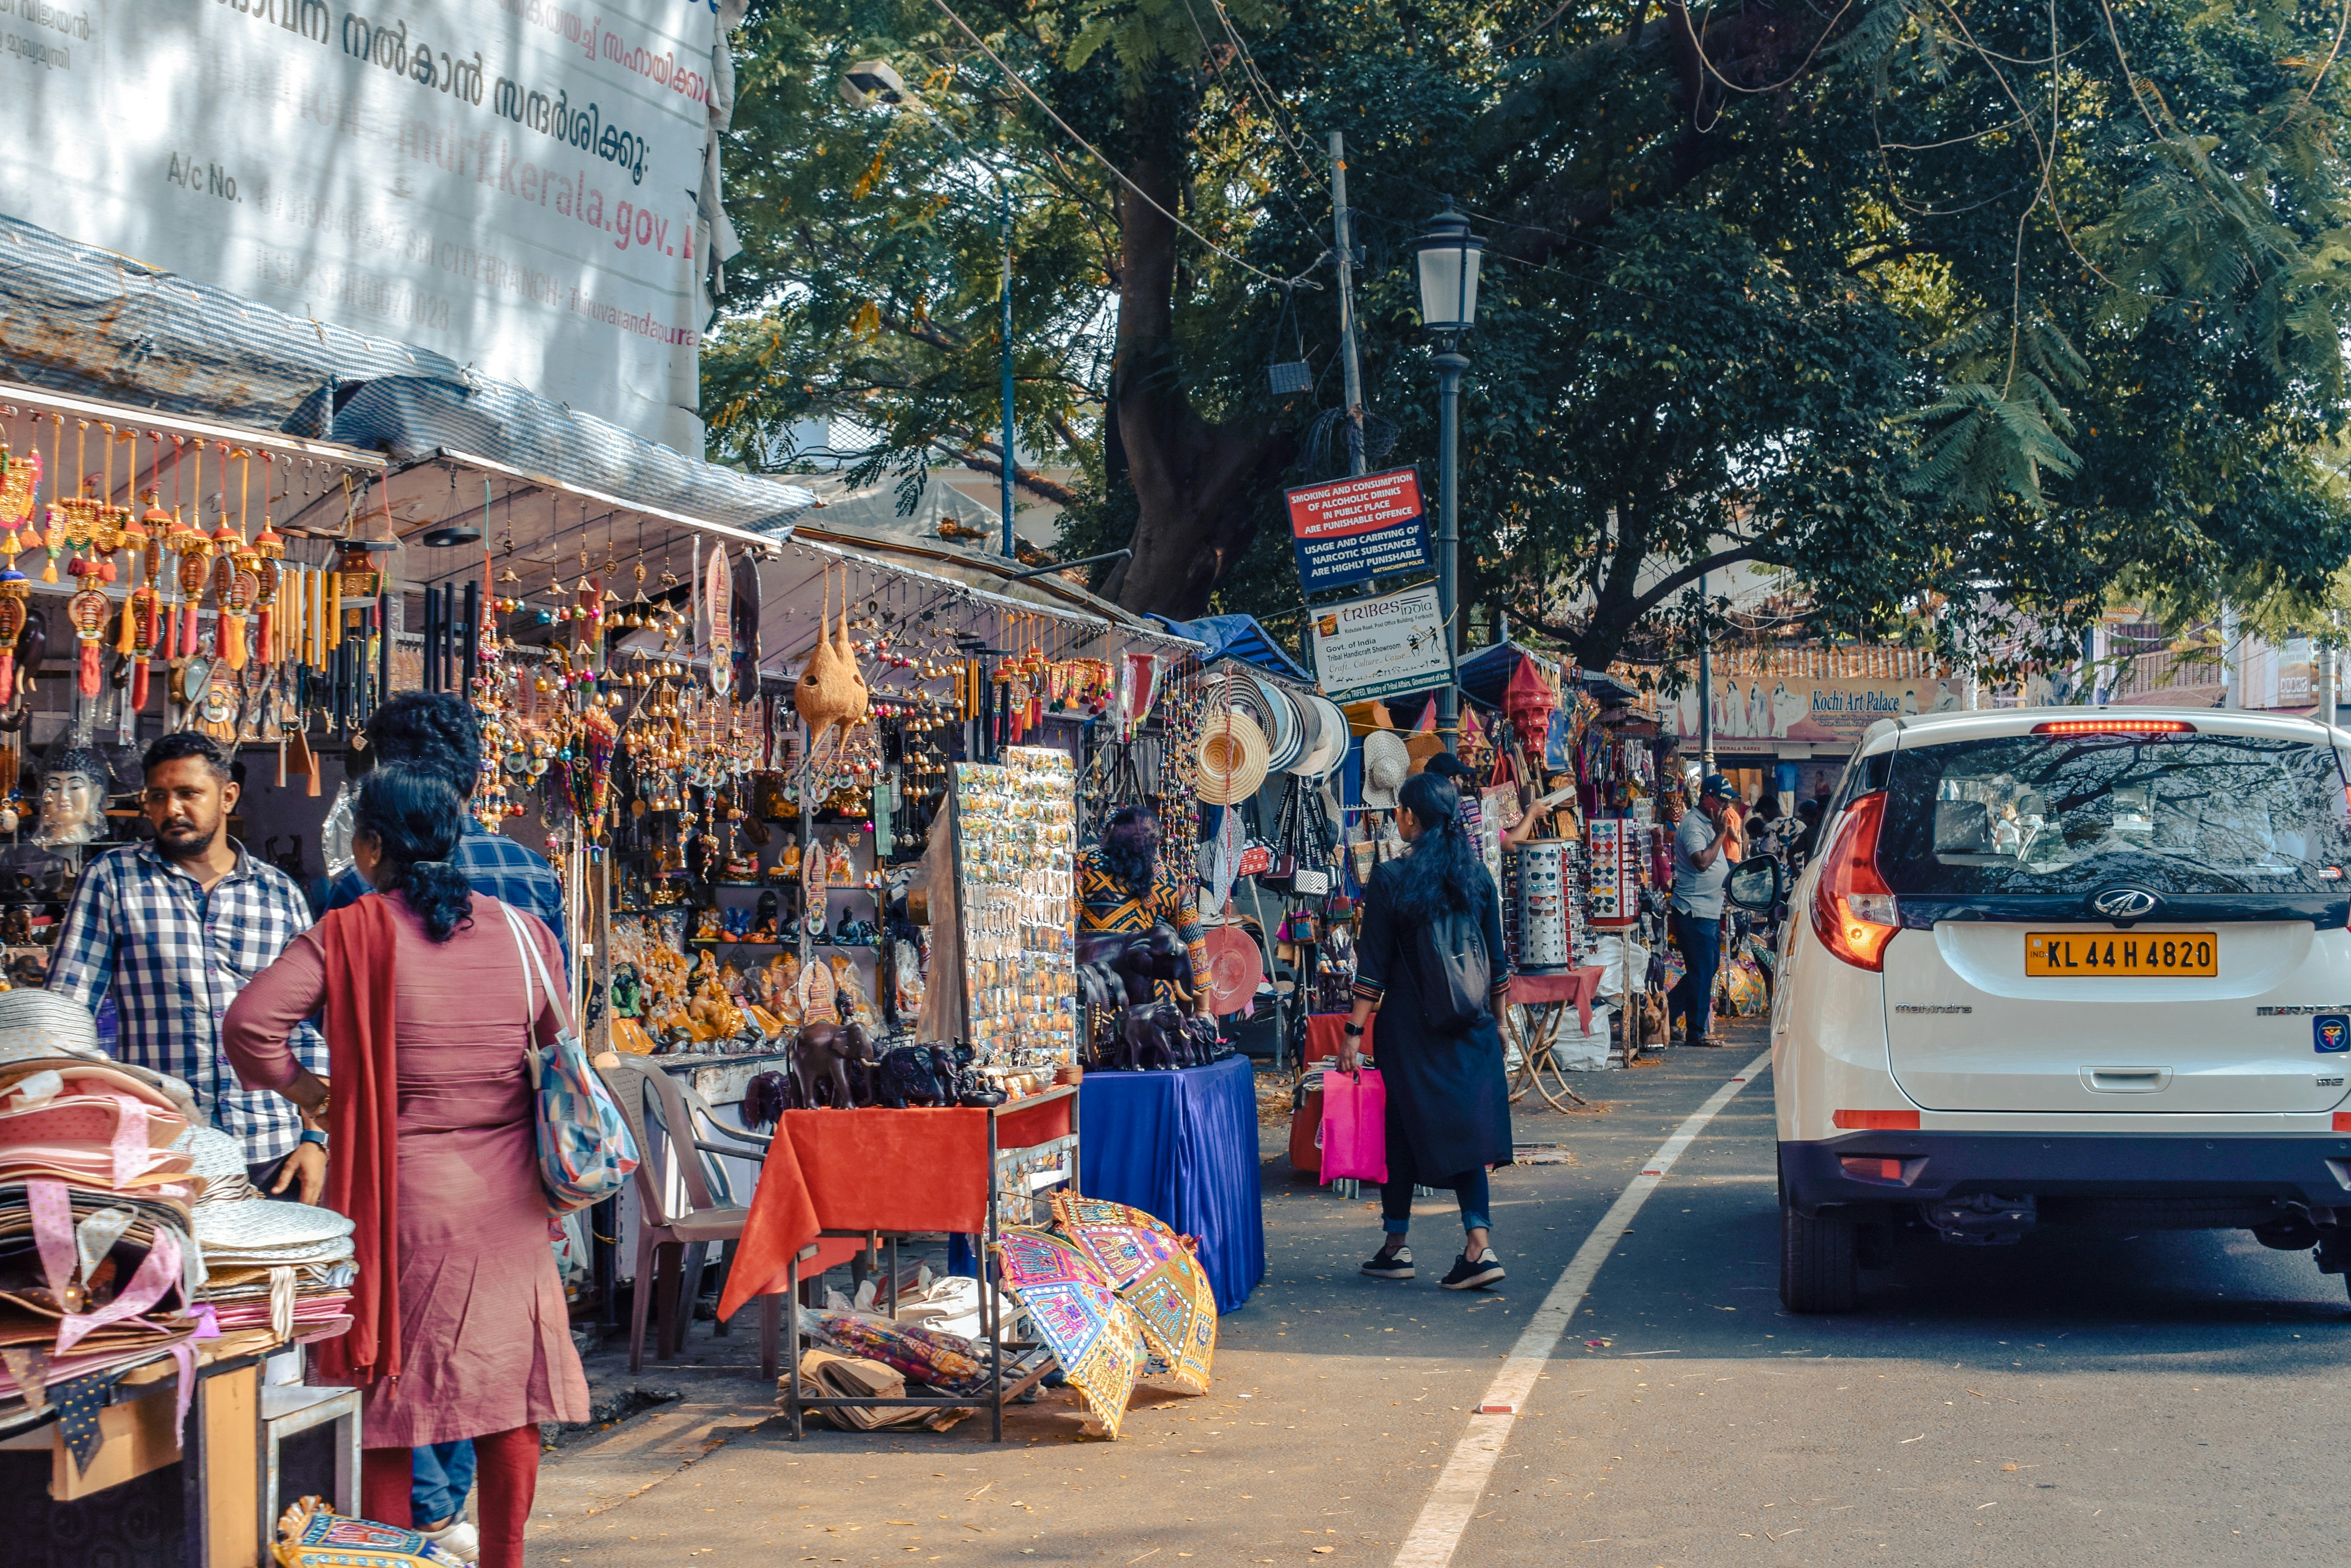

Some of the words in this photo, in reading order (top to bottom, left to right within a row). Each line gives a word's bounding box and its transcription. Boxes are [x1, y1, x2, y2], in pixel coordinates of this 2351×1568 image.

[343, 12, 484, 107] നൽകാൻ
[167, 151, 203, 191] A/c
[209, 162, 242, 204] No.
[1291, 490, 1330, 504] SMOKING
[1333, 485, 1351, 496] AND
[1352, 473, 1413, 492] CONSUMPTION
[1308, 502, 1320, 512] OF
[1321, 493, 1370, 509] ALCOHOLIC
[1371, 486, 1401, 500] DRINKS
[1305, 524, 1321, 534] ARE
[1323, 514, 1374, 531] PUNISHABLE
[1375, 506, 1413, 521] OFFENCE
[1323, 511, 1333, 520] IN
[1334, 505, 1363, 518] PUBLIC
[1364, 500, 1391, 512] PLACE
[1305, 542, 1335, 555] USAGE
[1337, 537, 1357, 549] AND
[1359, 528, 1405, 545] CARRYING
[1407, 525, 1420, 534] OF
[1312, 550, 1360, 565] NARCOTIC
[1361, 537, 1417, 556] SUBSTANCES
[1311, 566, 1330, 578] ARE
[1331, 559, 1365, 574] HIGHLY
[1366, 548, 1422, 567] PUNISHABLE
[1372, 562, 1408, 574] MATTANCHERRY
[1415, 612, 1434, 621] Fortkochi
[1326, 644, 1346, 653] Govt.
[1357, 638, 1376, 647] India
[1327, 653, 1343, 662] Tribal
[1343, 648, 1372, 659] Handicraft
[1372, 643, 1401, 653] Showroom
[1351, 688, 1366, 697] TRIFED,
[1366, 685, 1382, 695] Ministry
[1386, 682, 1398, 690] Tribal
[1398, 679, 1412, 689] Affairs,
[1412, 676, 1435, 686] Government
[1440, 672, 1450, 680] India
[1812, 689, 1843, 712] Kochi
[1845, 690, 1864, 712] Art
[1866, 690, 1899, 713] Palace
[1316, 848, 1324, 867] FOREVER
[2048, 941, 2078, 967] KL
[2086, 941, 2116, 967] 44
[2124, 941, 2138, 967] H
[2146, 941, 2211, 967] 4820
